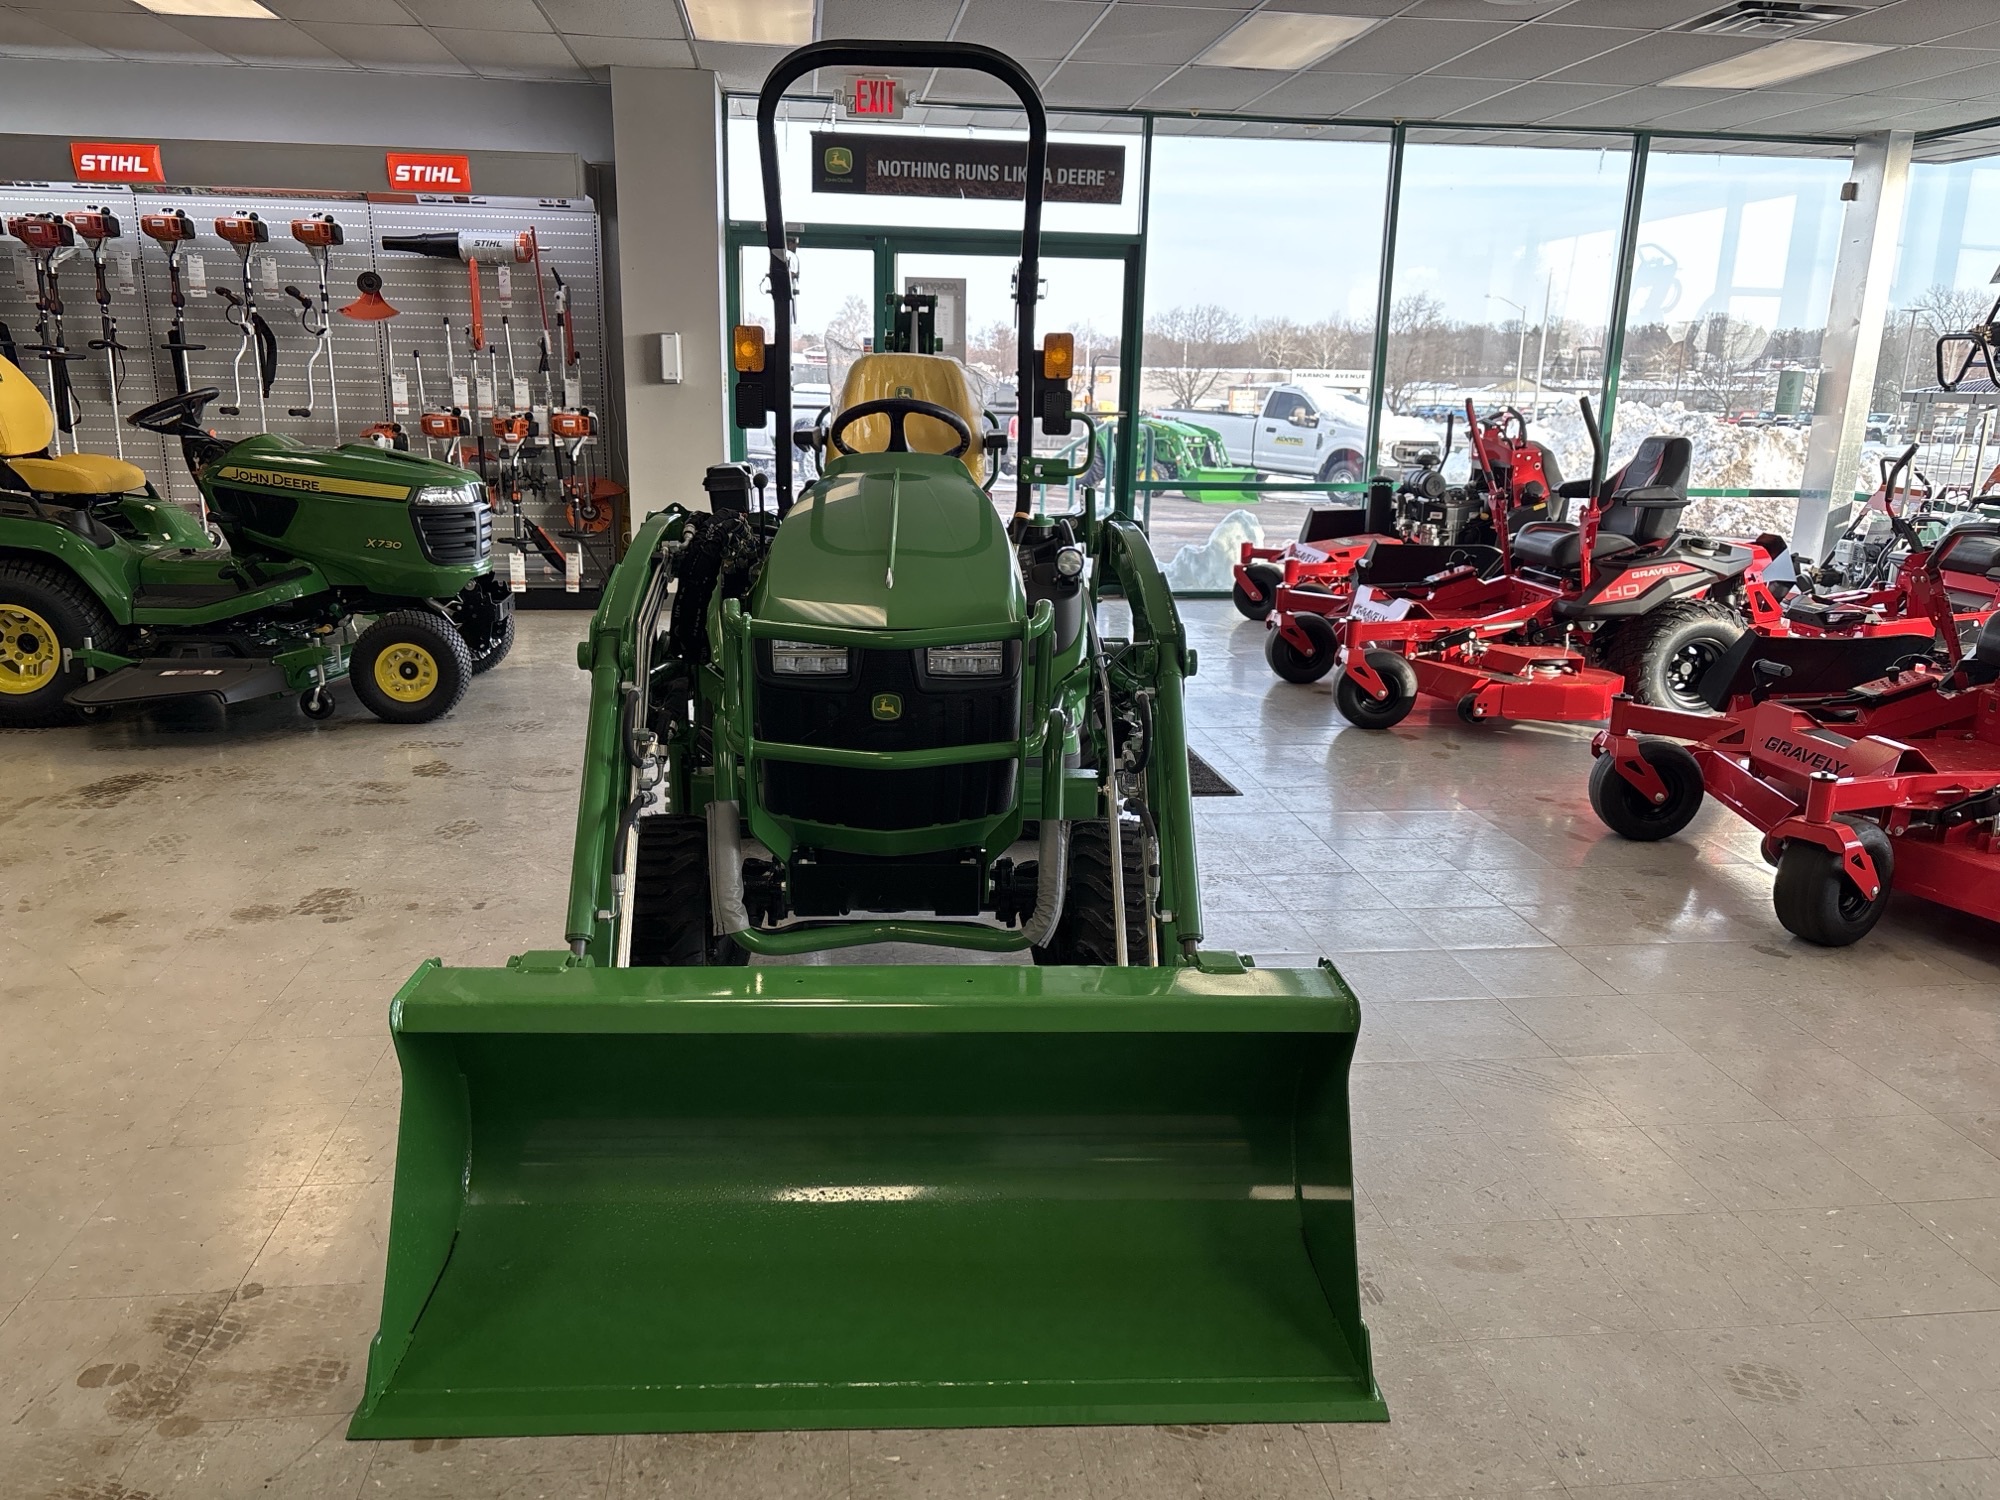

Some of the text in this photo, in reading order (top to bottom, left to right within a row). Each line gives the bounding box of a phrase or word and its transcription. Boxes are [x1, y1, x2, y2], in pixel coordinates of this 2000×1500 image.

[857, 80, 896, 113] EXIT
[81, 154, 149, 173] STIHL
[877, 160, 950, 178] NOTHING
[955, 163, 1000, 182] RUNS
[1004, 166, 1028, 182] LIK
[395, 165, 461, 183] STIHL
[473, 239, 503, 248] STIHL
[231, 468, 320, 491] JOHN DEERE
[365, 538, 402, 550] X730
[1631, 565, 1682, 579] GRAVELY
[1606, 583, 1640, 599] HD
[1764, 736, 1848, 774] GRAVELY
